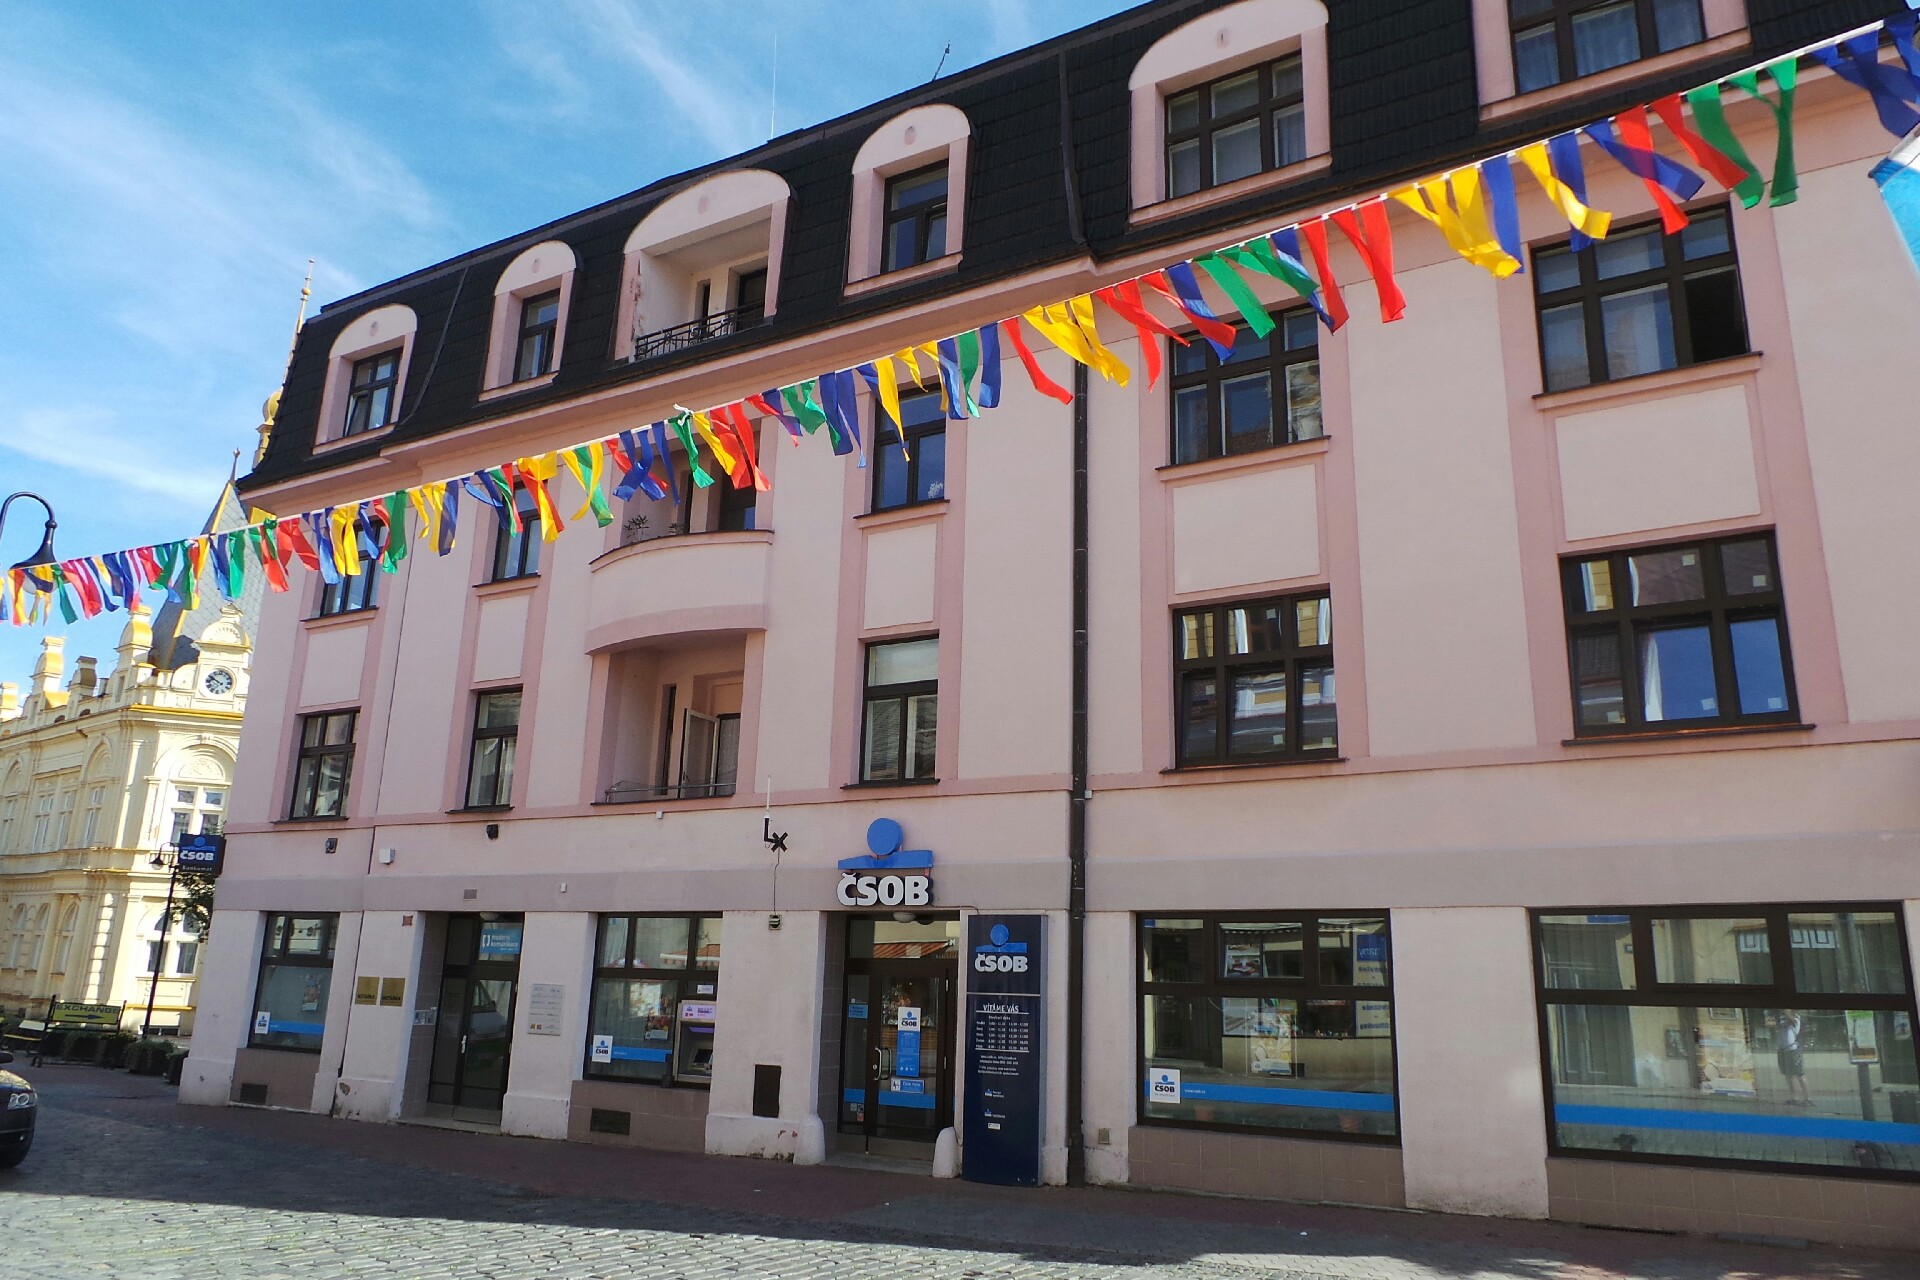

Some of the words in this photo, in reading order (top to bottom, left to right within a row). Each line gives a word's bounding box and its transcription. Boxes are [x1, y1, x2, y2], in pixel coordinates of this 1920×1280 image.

[180, 849, 215, 861] ČSOB
[836, 872, 931, 906] ČSOB
[975, 953, 1029, 973] ČSOB
[55, 1004, 120, 1014] EXCHANGE
[983, 1003, 1006, 1012] VÍTÁME
[1006, 1004, 1019, 1013] VÁS
[1154, 1085, 1175, 1093] ČSOB
